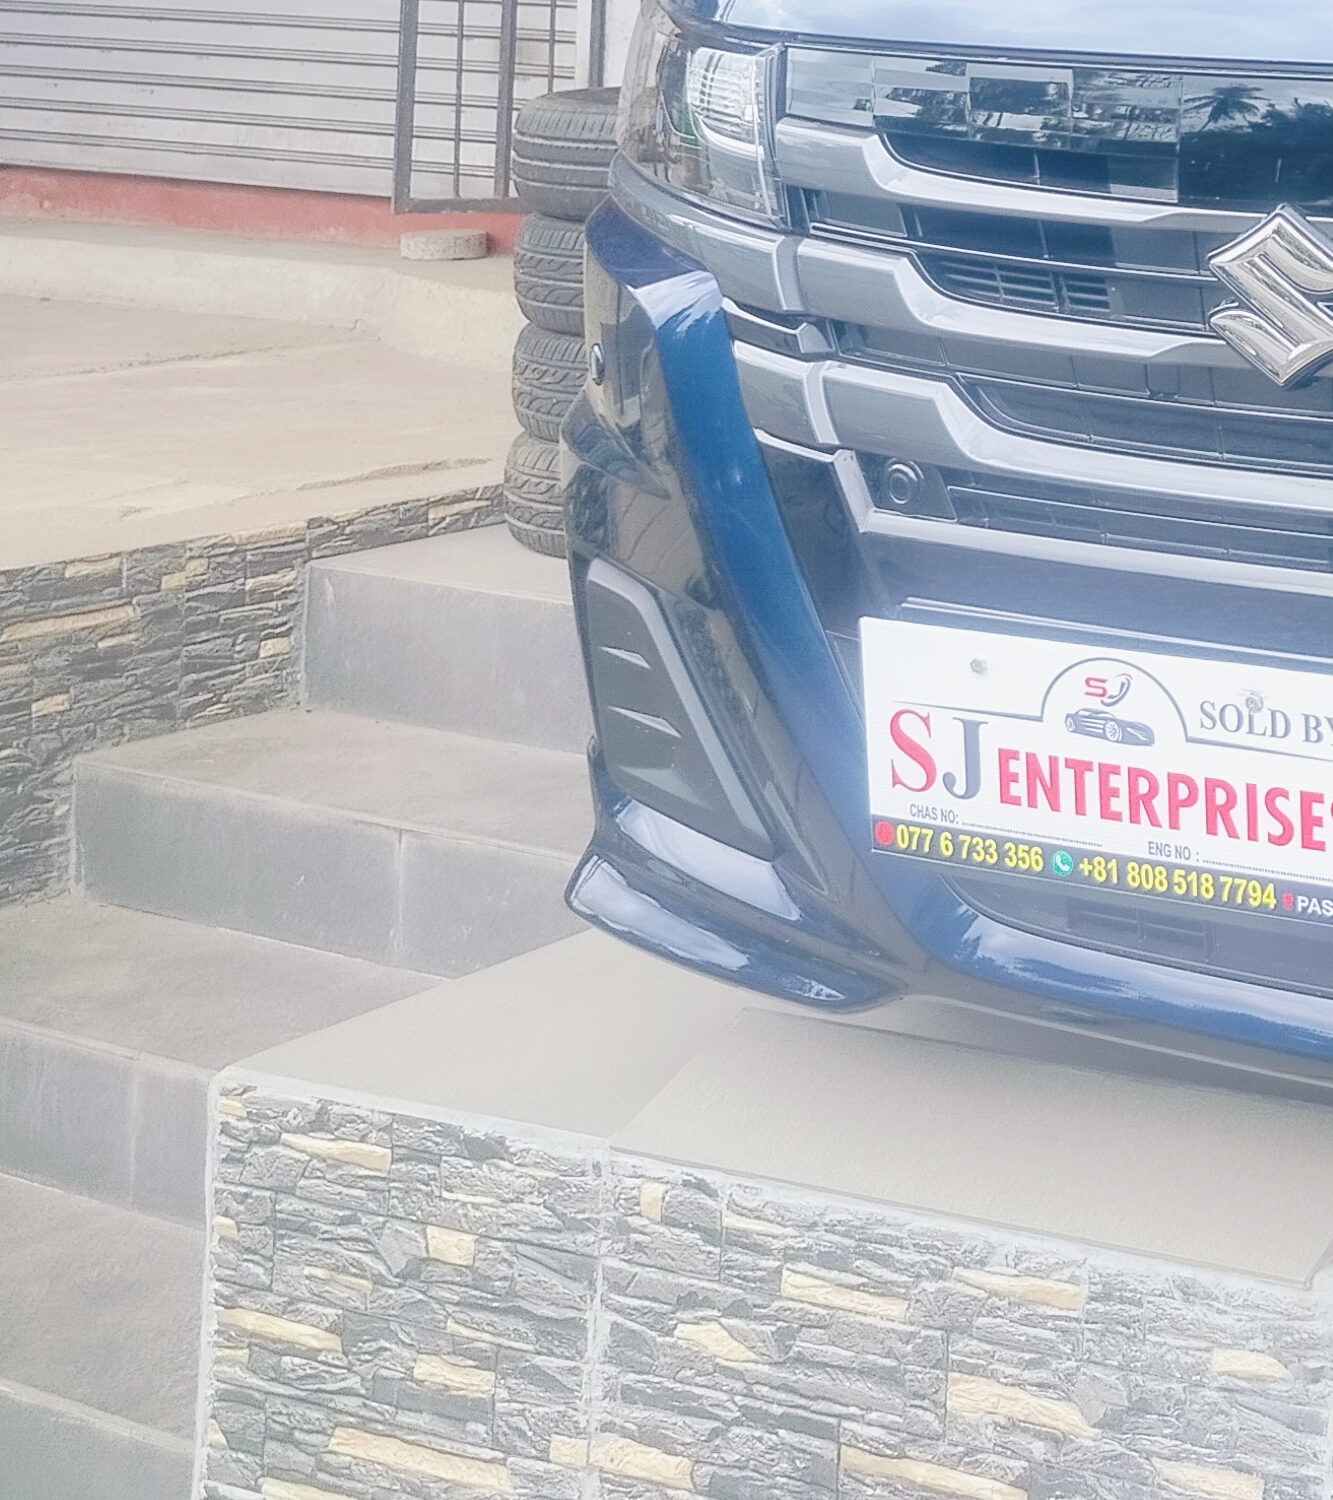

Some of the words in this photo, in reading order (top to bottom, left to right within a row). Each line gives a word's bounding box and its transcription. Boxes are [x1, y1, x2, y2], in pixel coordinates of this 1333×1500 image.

[1200, 700, 1291, 739] SOLD
[890, 707, 988, 800] SJ
[909, 803, 938, 820] CHAS
[896, 824, 934, 852] 077
[940, 832, 953, 856] 6
[958, 835, 998, 864] 733
[1004, 842, 1044, 872] 356
[1147, 840, 1172, 858] ENG
[1079, 856, 1118, 884] +81
[1127, 861, 1168, 892] 808
[1173, 869, 1214, 899] 518
[1220, 876, 1276, 909] 7794
